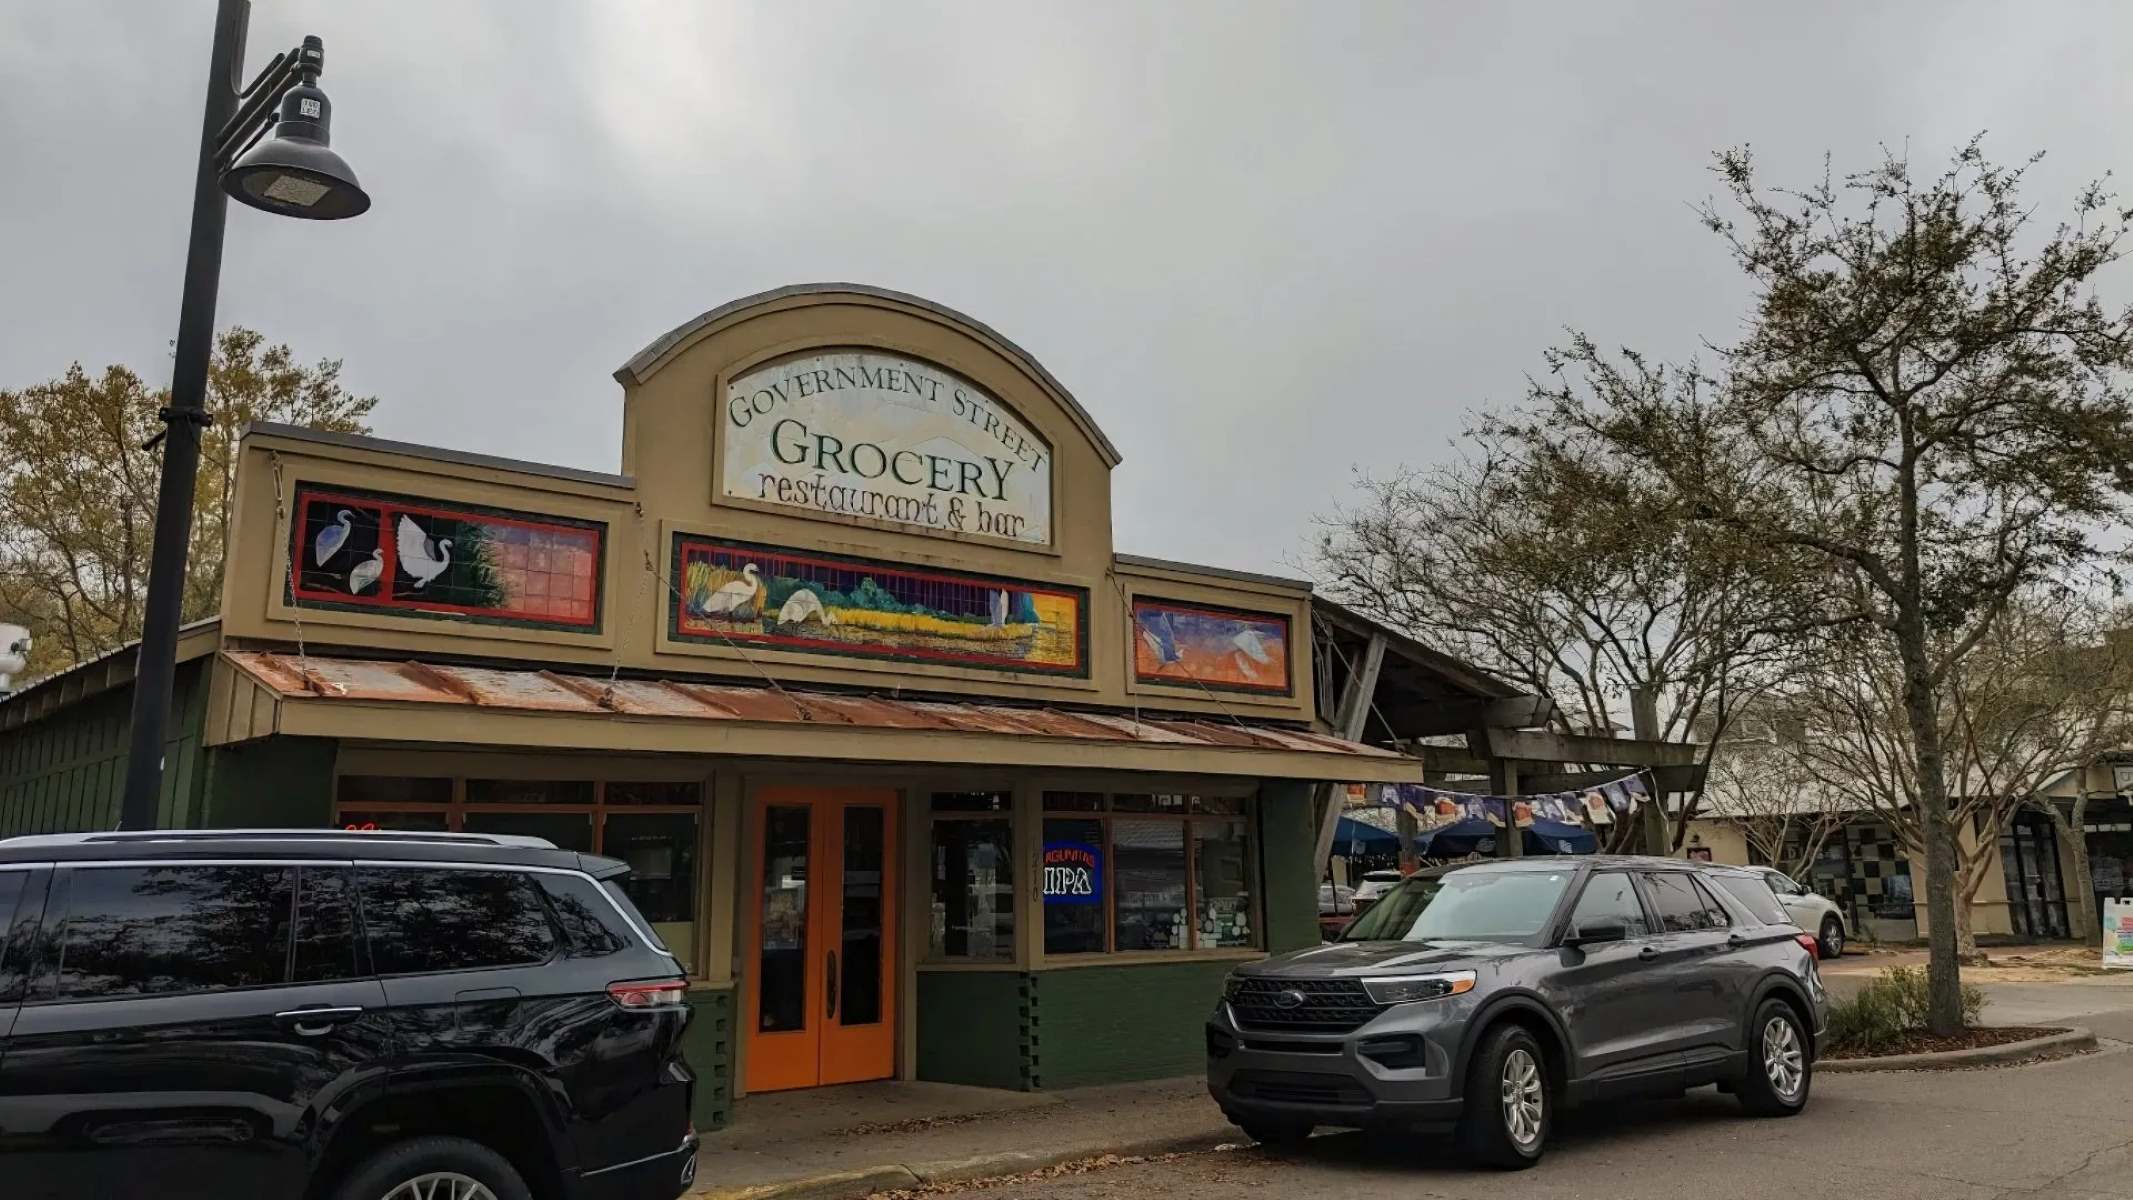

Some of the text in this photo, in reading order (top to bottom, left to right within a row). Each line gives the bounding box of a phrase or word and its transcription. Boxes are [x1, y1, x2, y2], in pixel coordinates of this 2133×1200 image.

[729, 366, 1048, 473] GOVERNMENT STREET
[770, 418, 1014, 502] GROCERY
[758, 472, 1025, 539] restaurant & bar
[1043, 866, 1092, 895] IPA
